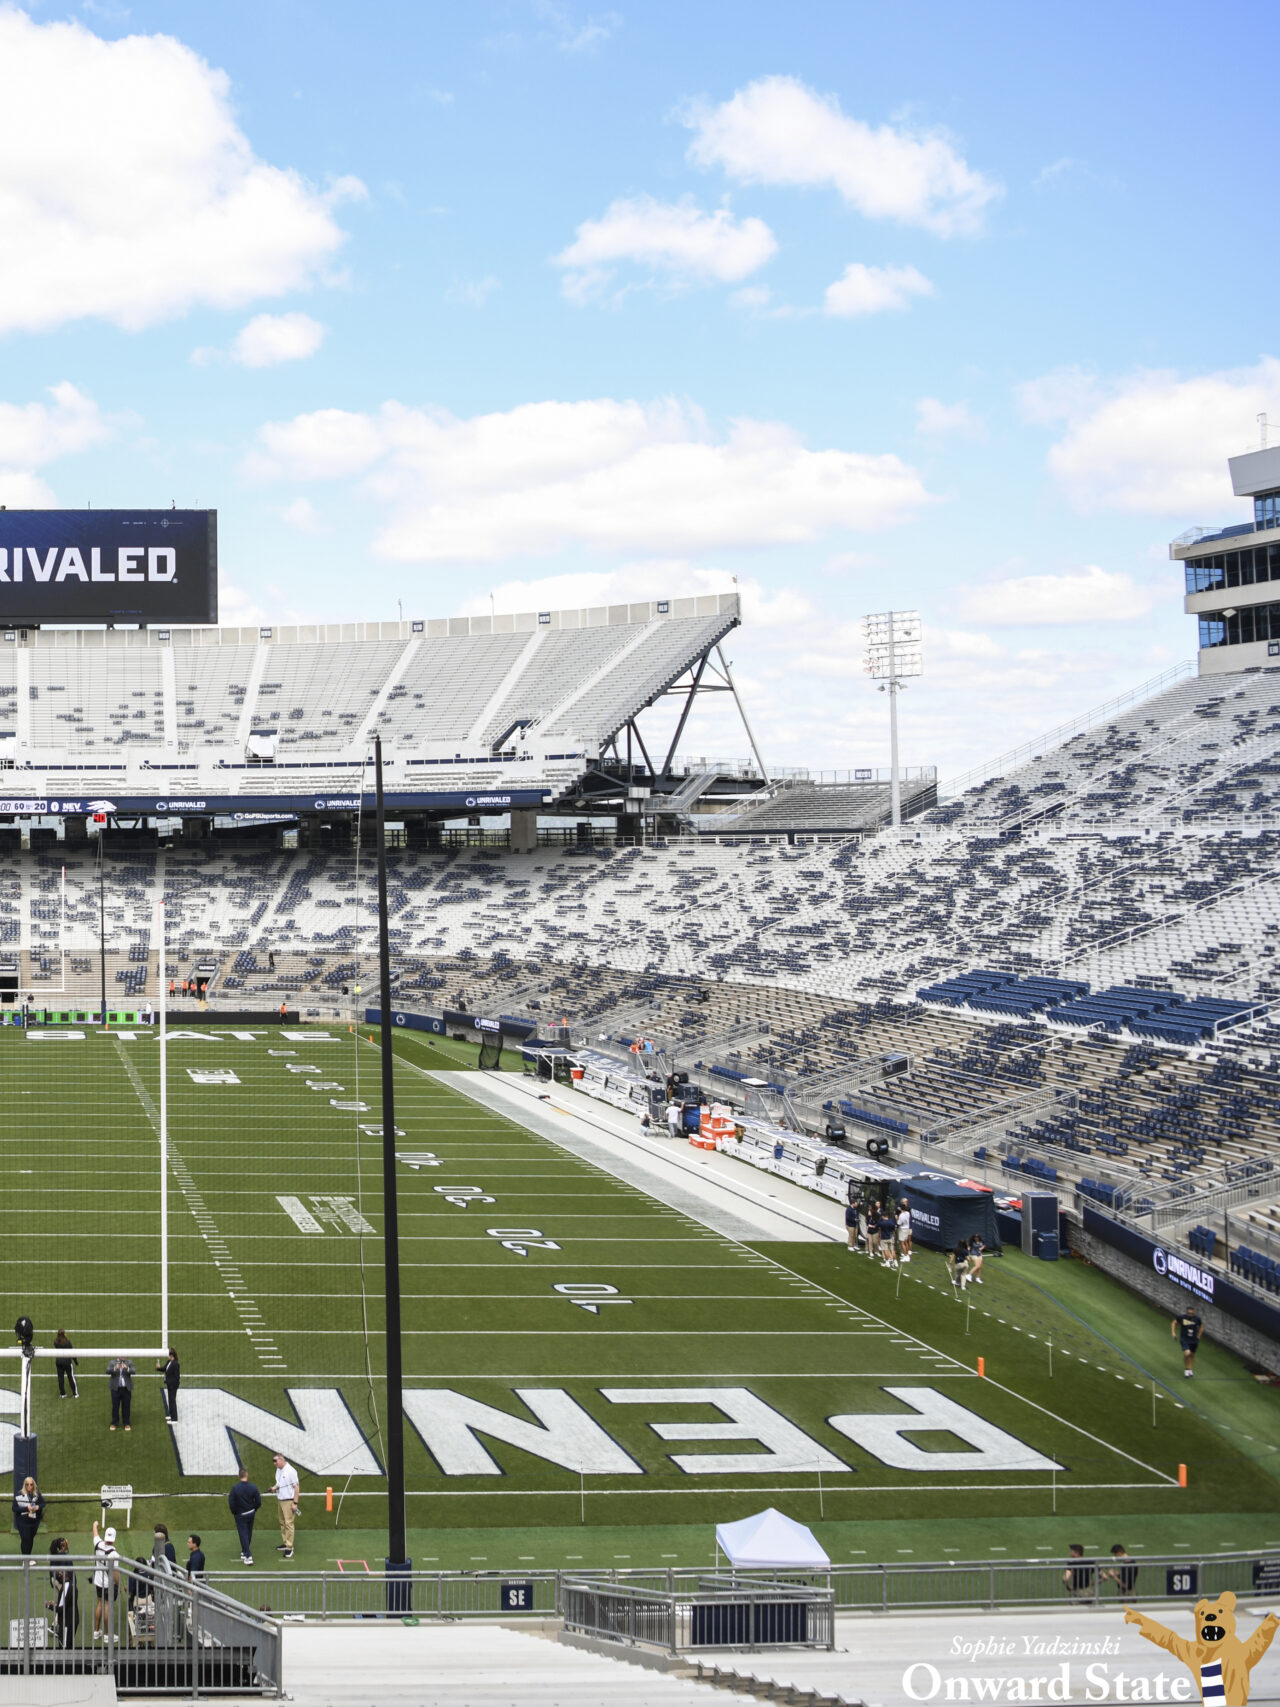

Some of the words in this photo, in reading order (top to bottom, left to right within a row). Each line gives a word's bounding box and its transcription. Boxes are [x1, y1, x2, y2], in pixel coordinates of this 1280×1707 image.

[34, 802, 46, 810] 20
[476, 796, 511, 804] UNRIVALED
[25, 1030, 342, 1041] STATE
[433, 1185, 497, 1204] 30
[910, 1208, 940, 1226] NRIVALED
[485, 1228, 563, 1250] 20
[1167, 1253, 1214, 1295] UNRIVALED
[551, 1283, 635, 1304] 10
[166, 1385, 1070, 1477] PENN
[1173, 1574, 1191, 1591] SD
[509, 1589, 525, 1606] SE
